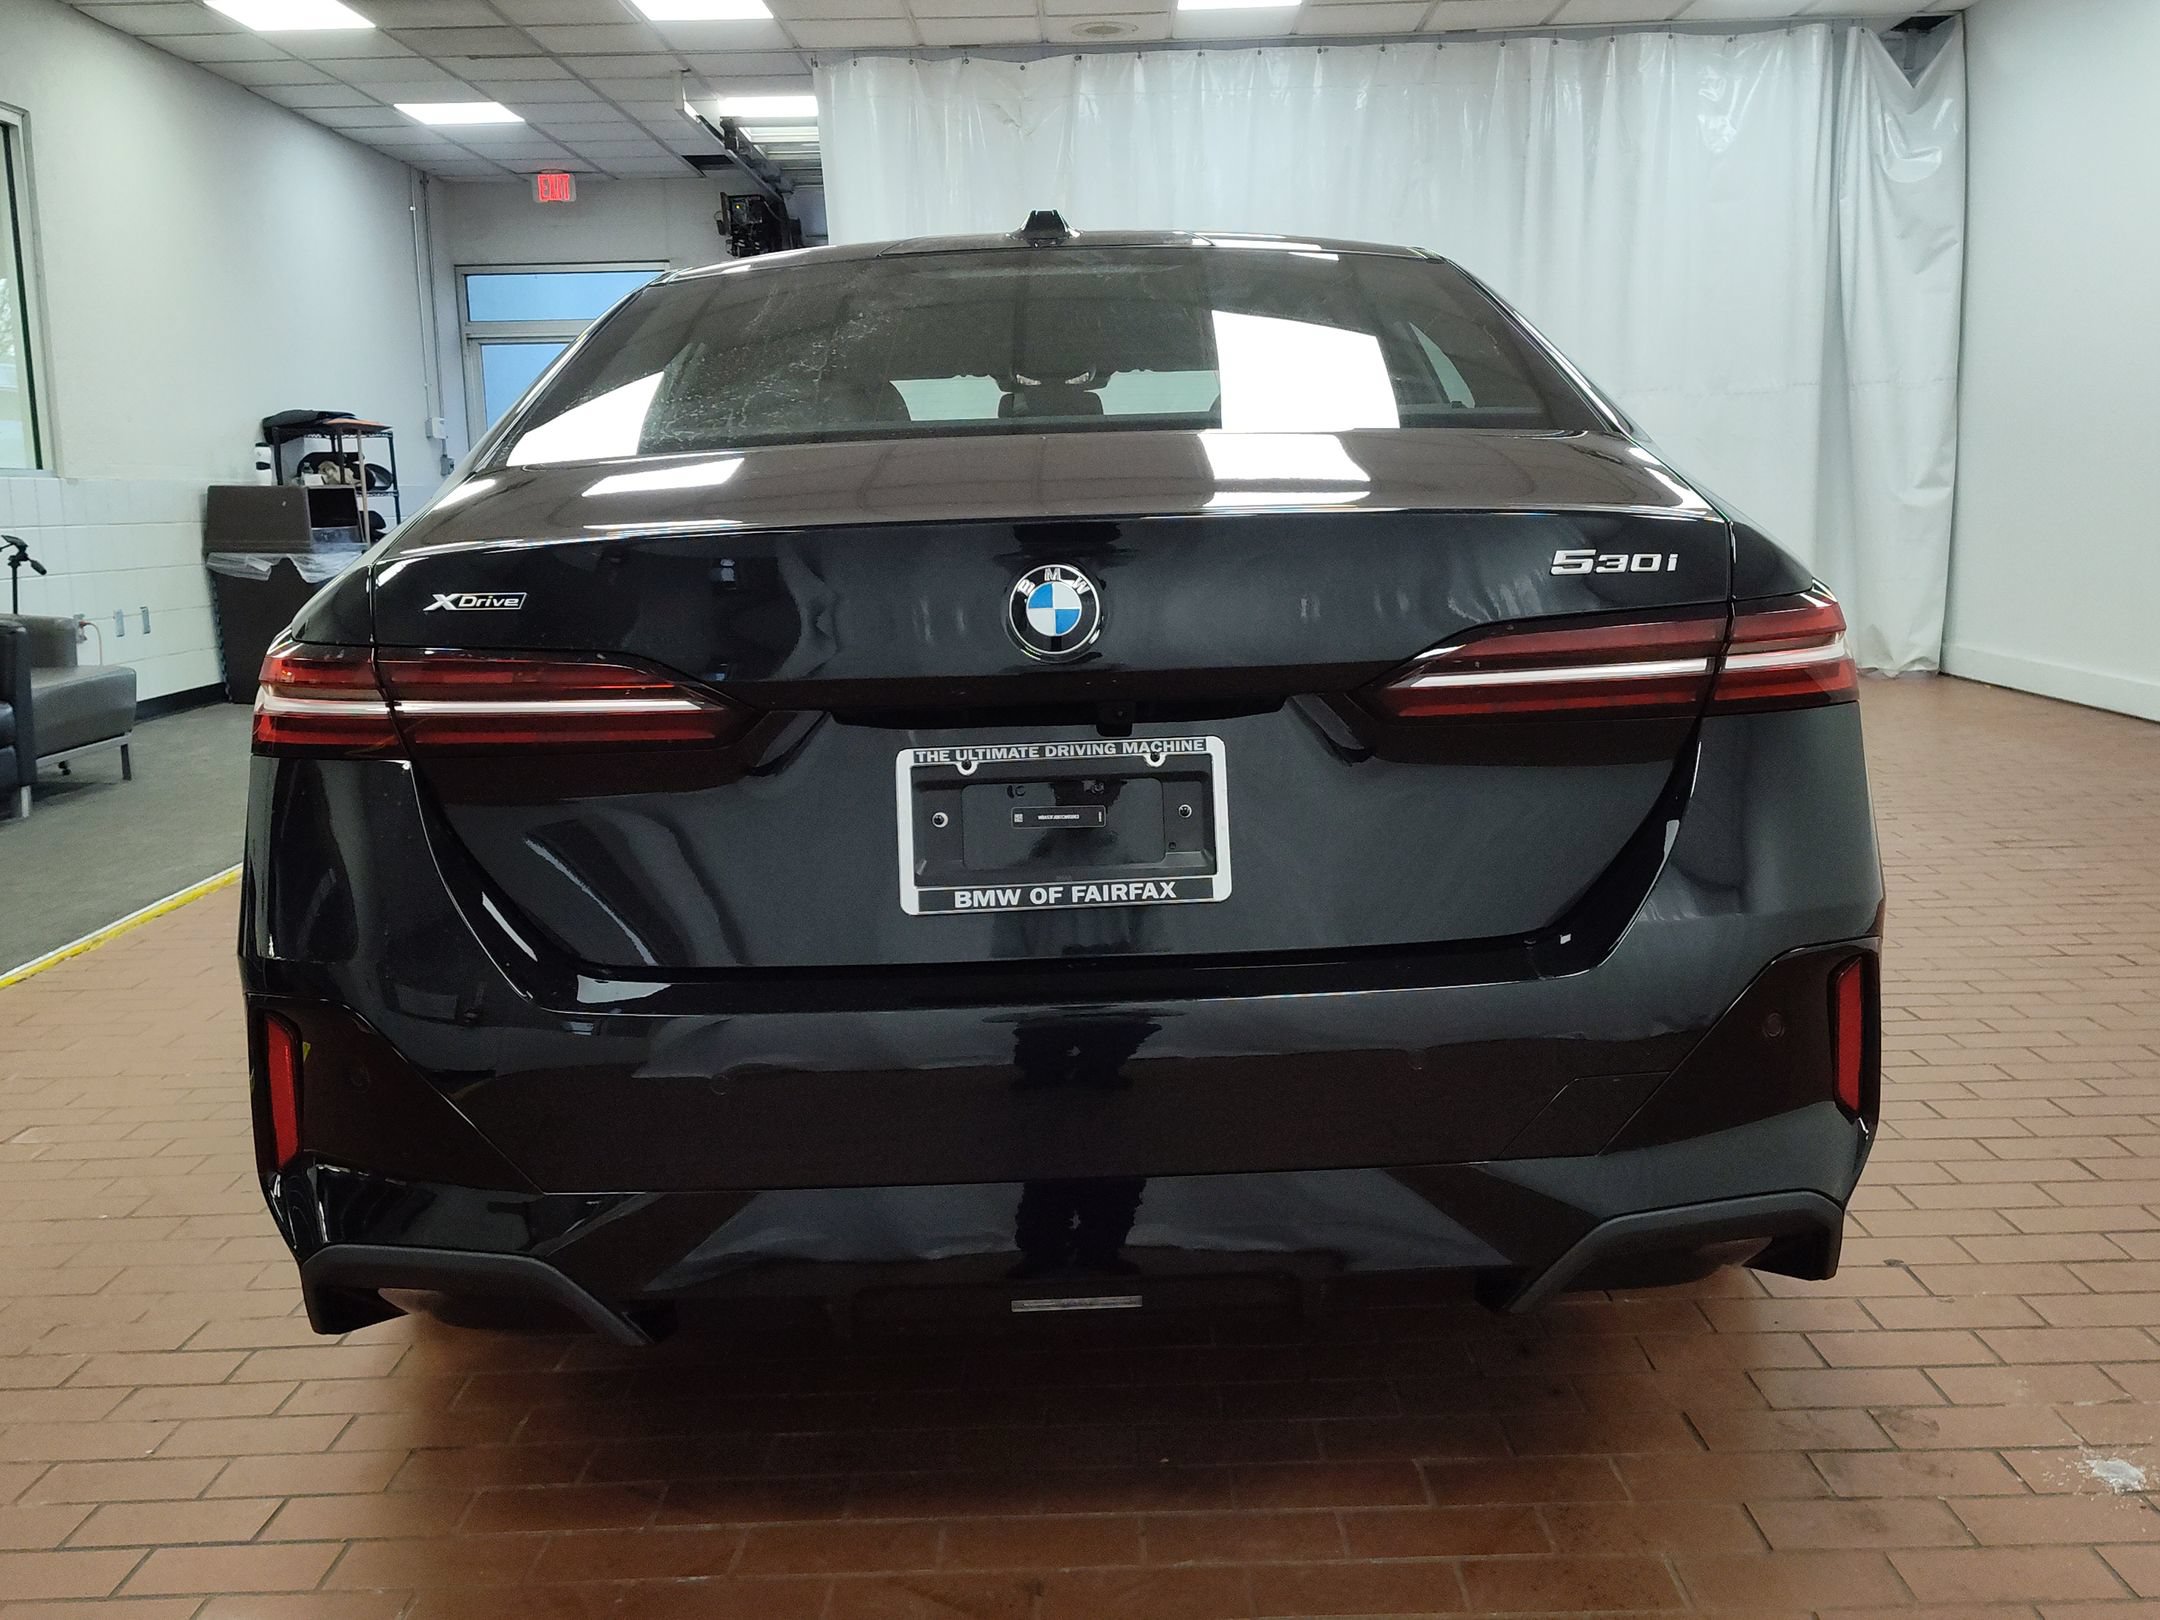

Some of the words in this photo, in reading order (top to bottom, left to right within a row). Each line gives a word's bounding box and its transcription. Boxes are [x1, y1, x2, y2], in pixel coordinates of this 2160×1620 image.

[538, 174, 570, 202] EXIT
[1551, 549, 1679, 575] 530i
[1016, 567, 1091, 597] BMW
[916, 750, 951, 763] THE
[955, 746, 1040, 761] ULTIMATE
[1044, 742, 1117, 758] DRIVING
[1122, 739, 1205, 755] MACHINE
[954, 888, 1021, 908] BMW
[1030, 886, 1063, 905] OF
[1071, 881, 1177, 903] FAIRFAX
